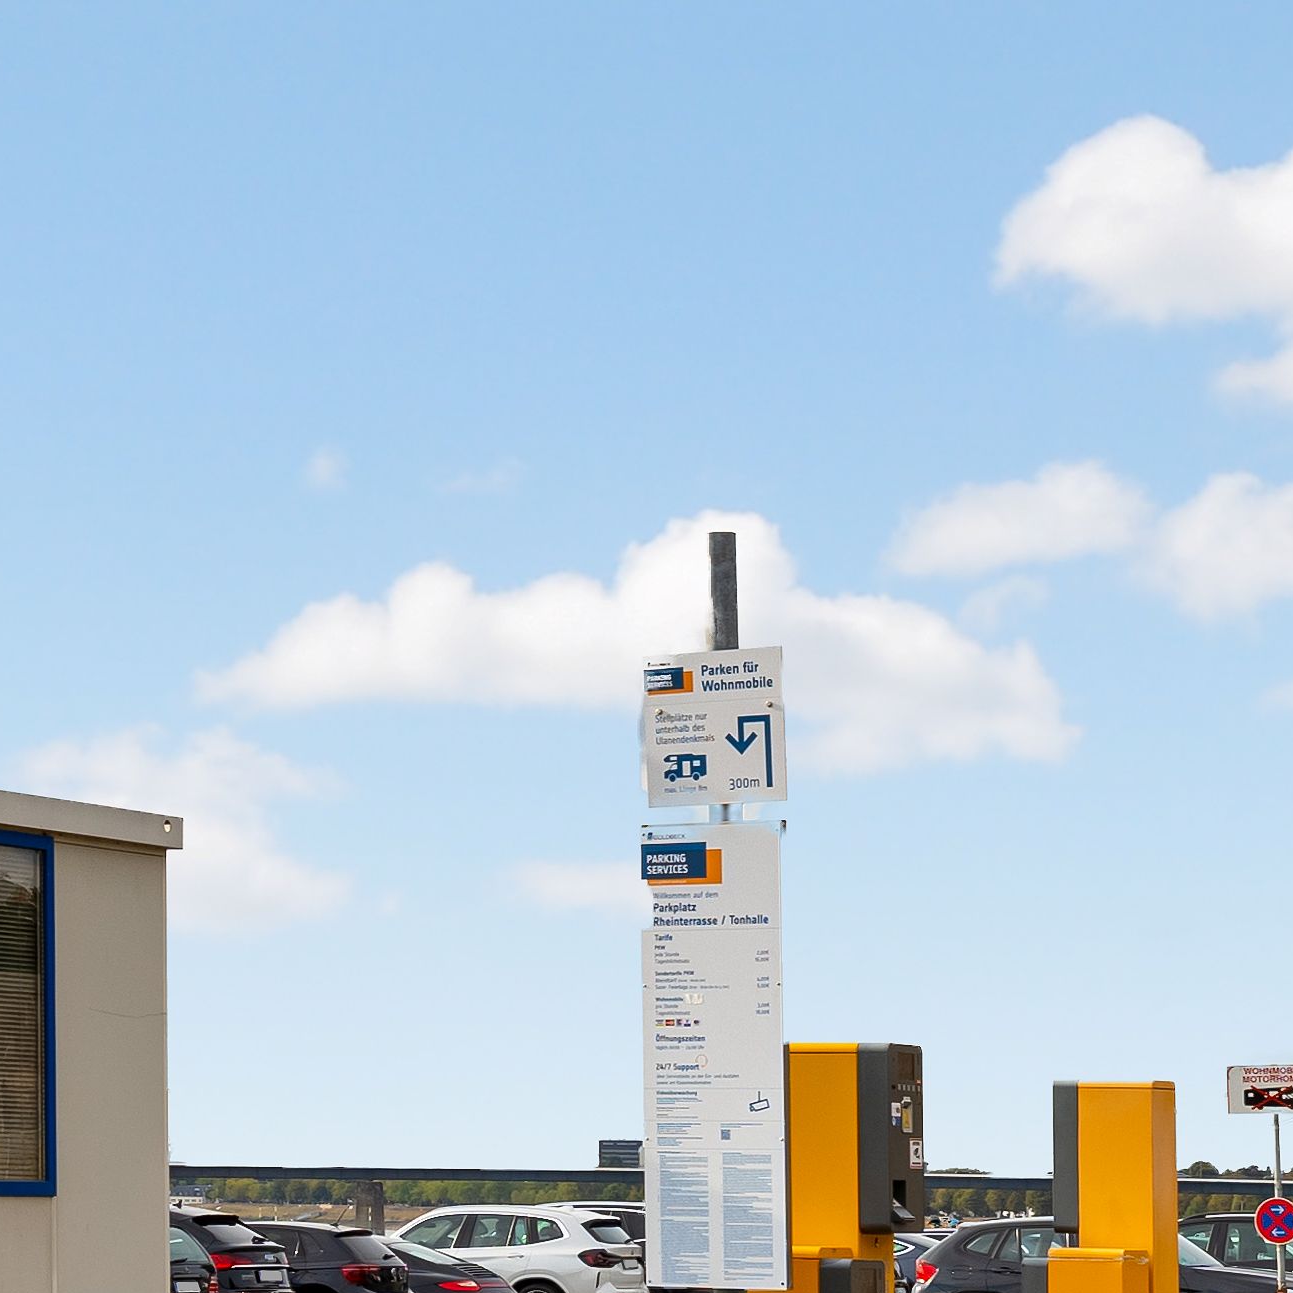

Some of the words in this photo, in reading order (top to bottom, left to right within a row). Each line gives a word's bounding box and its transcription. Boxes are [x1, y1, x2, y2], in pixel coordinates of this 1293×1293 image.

[701, 664, 739, 677] Parken
[743, 661, 759, 674] für
[701, 678, 773, 692] Wohnmobile
[695, 713, 708, 721] nur
[655, 725, 689, 734] unterhalb
[692, 724, 706, 732] des
[729, 777, 760, 791] 300m
[646, 854, 687, 864] PARKING
[646, 864, 689, 875] SERVICES
[653, 903, 697, 914] Parkplatz
[653, 917, 718, 927] Rheinterrasse
[729, 914, 769, 925] Tonhalle
[655, 1033, 706, 1044] Öffnungszeiten
[673, 1063, 700, 1072] Support
